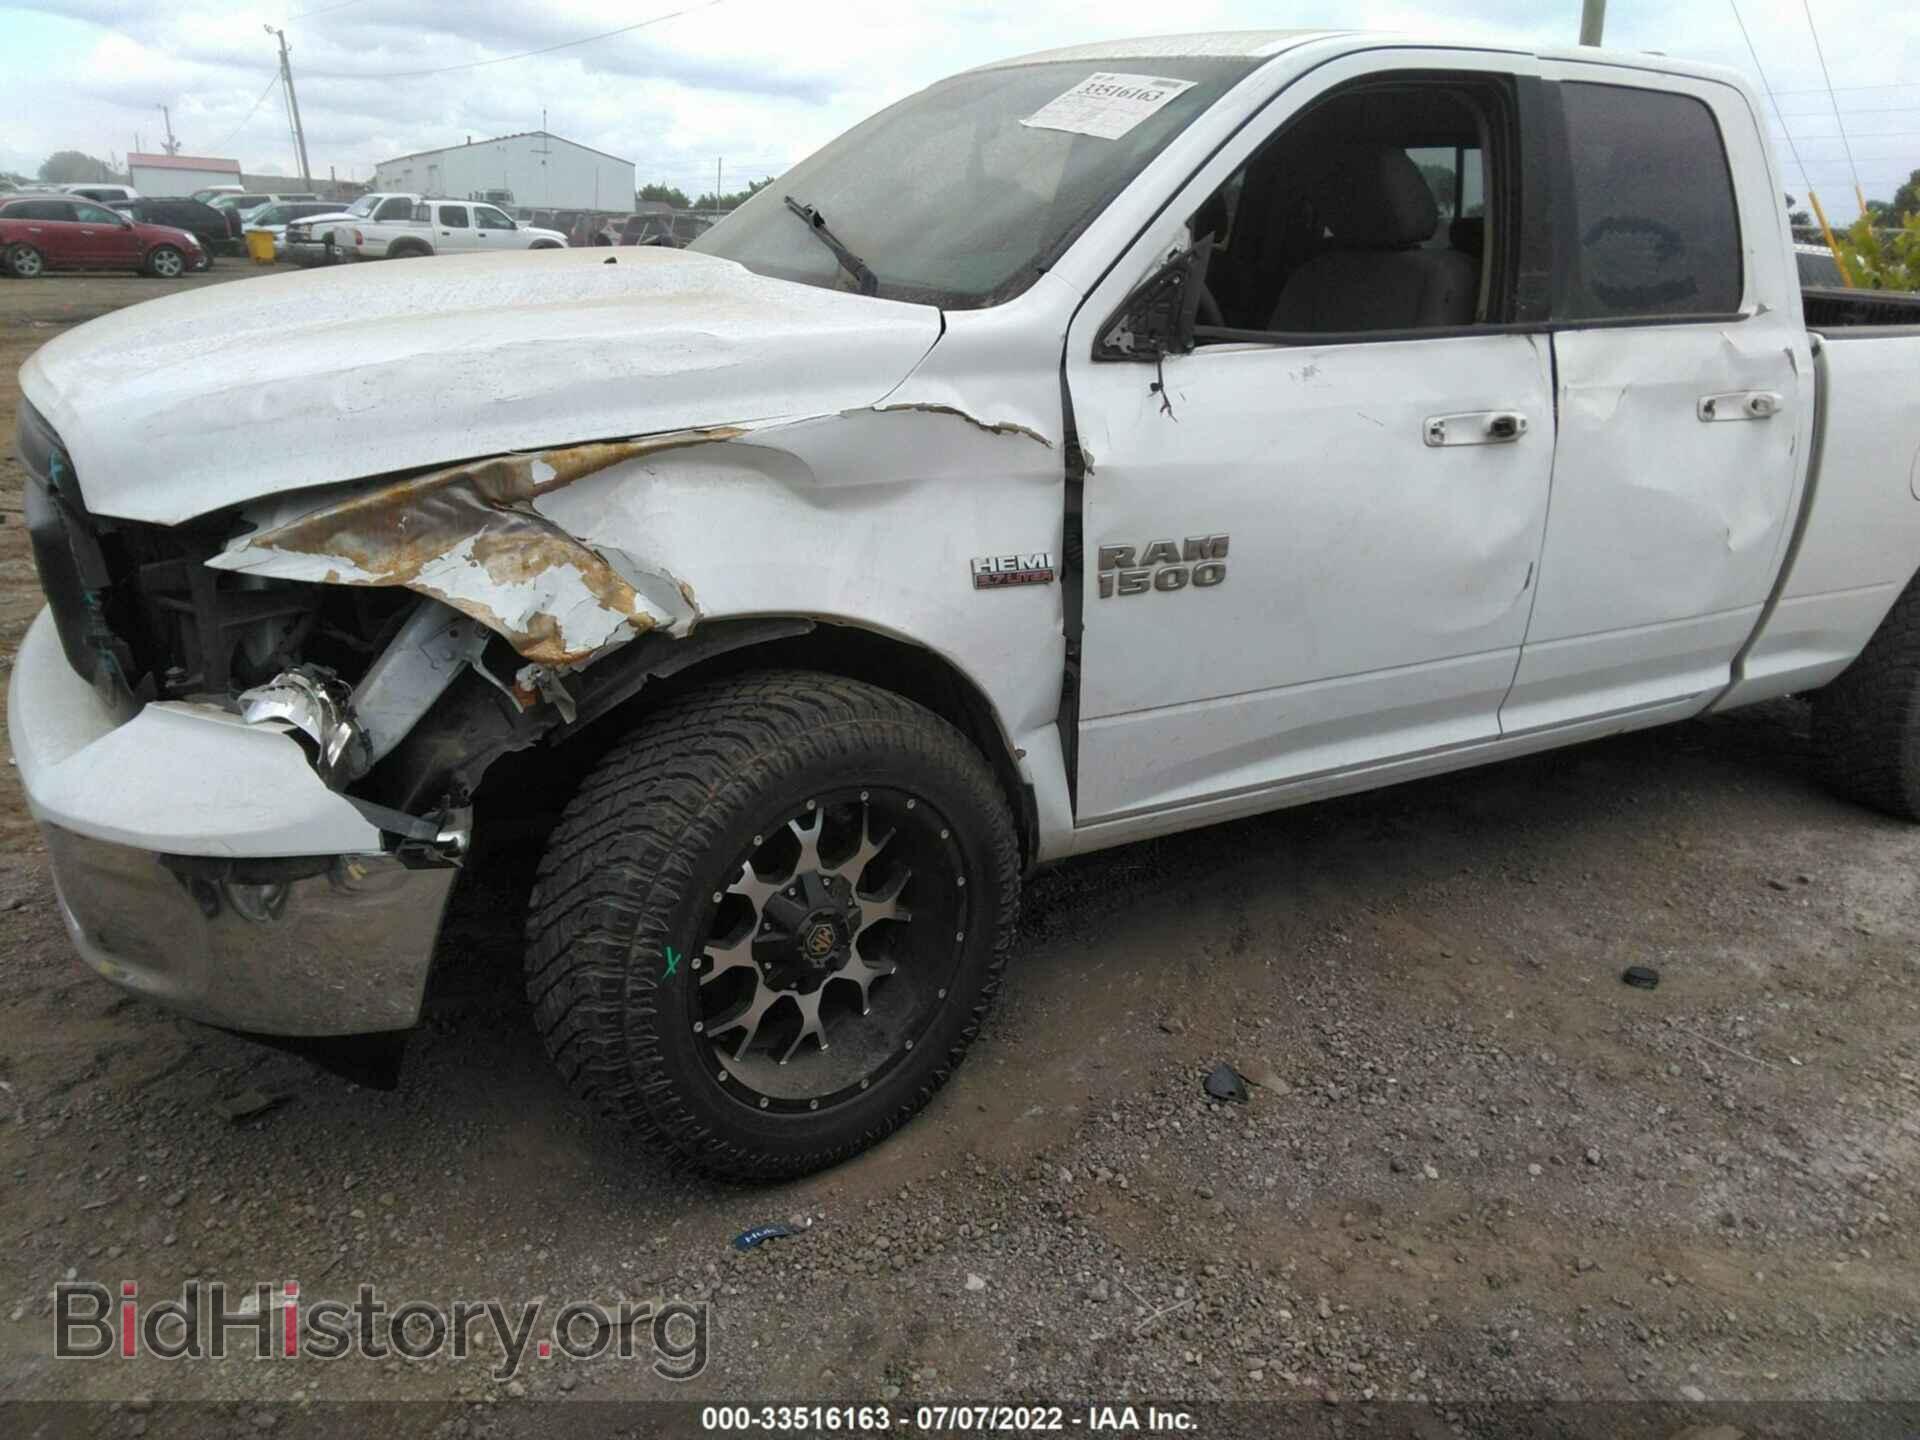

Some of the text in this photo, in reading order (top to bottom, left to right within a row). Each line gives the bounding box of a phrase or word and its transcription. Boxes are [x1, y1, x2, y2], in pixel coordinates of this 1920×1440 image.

[1077, 83, 1165, 102] 33516163
[970, 552, 1054, 574] HEMI
[1099, 533, 1229, 569] RAM
[1098, 560, 1227, 599] 1500
